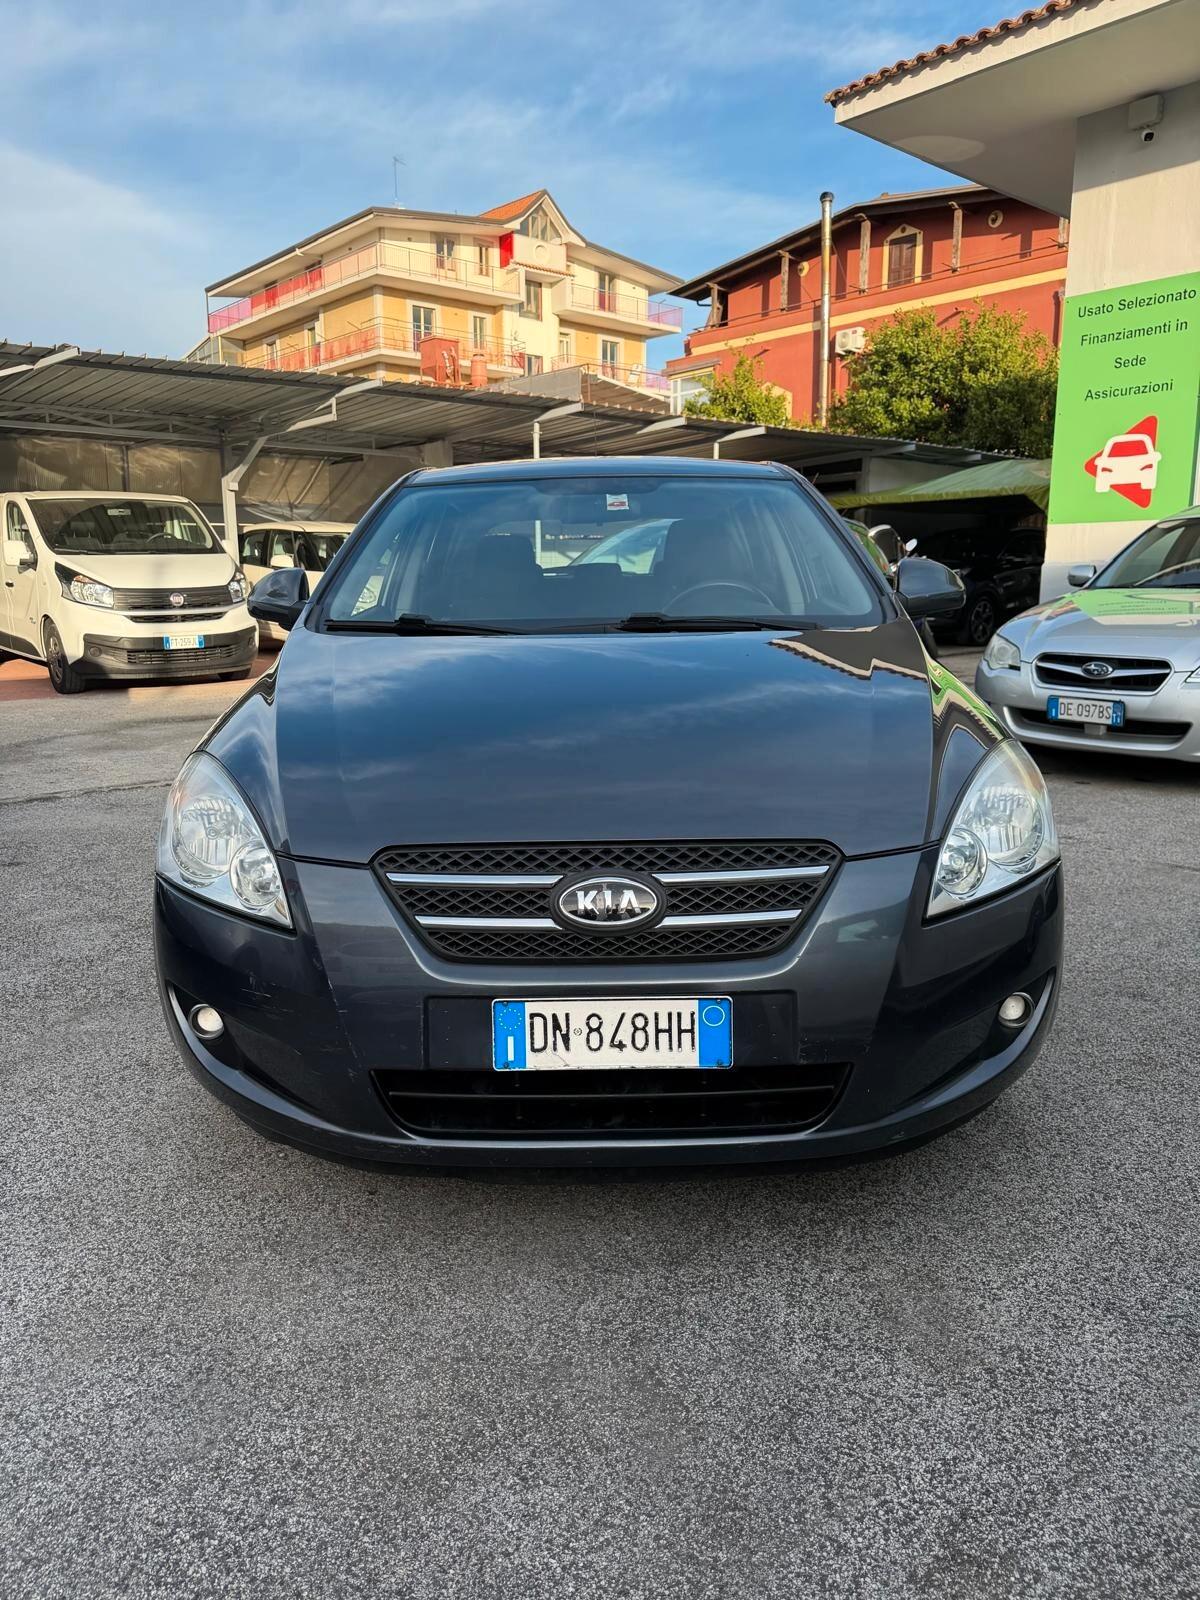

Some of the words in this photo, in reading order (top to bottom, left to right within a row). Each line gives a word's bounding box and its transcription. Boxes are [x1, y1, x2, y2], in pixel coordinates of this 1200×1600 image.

[1078, 303, 1114, 318] Usato
[1118, 288, 1197, 311] Selezionato
[1080, 320, 1171, 346] Finanziamenti
[1175, 318, 1188, 332] in
[1113, 354, 1147, 369] Sede
[1084, 379, 1174, 401] Assicurazioni
[1059, 702, 1073, 716] DE
[1076, 703, 1112, 720] 097BS
[576, 889, 641, 915] KIA
[529, 1012, 571, 1053] DN
[585, 1011, 696, 1053] 848HH
